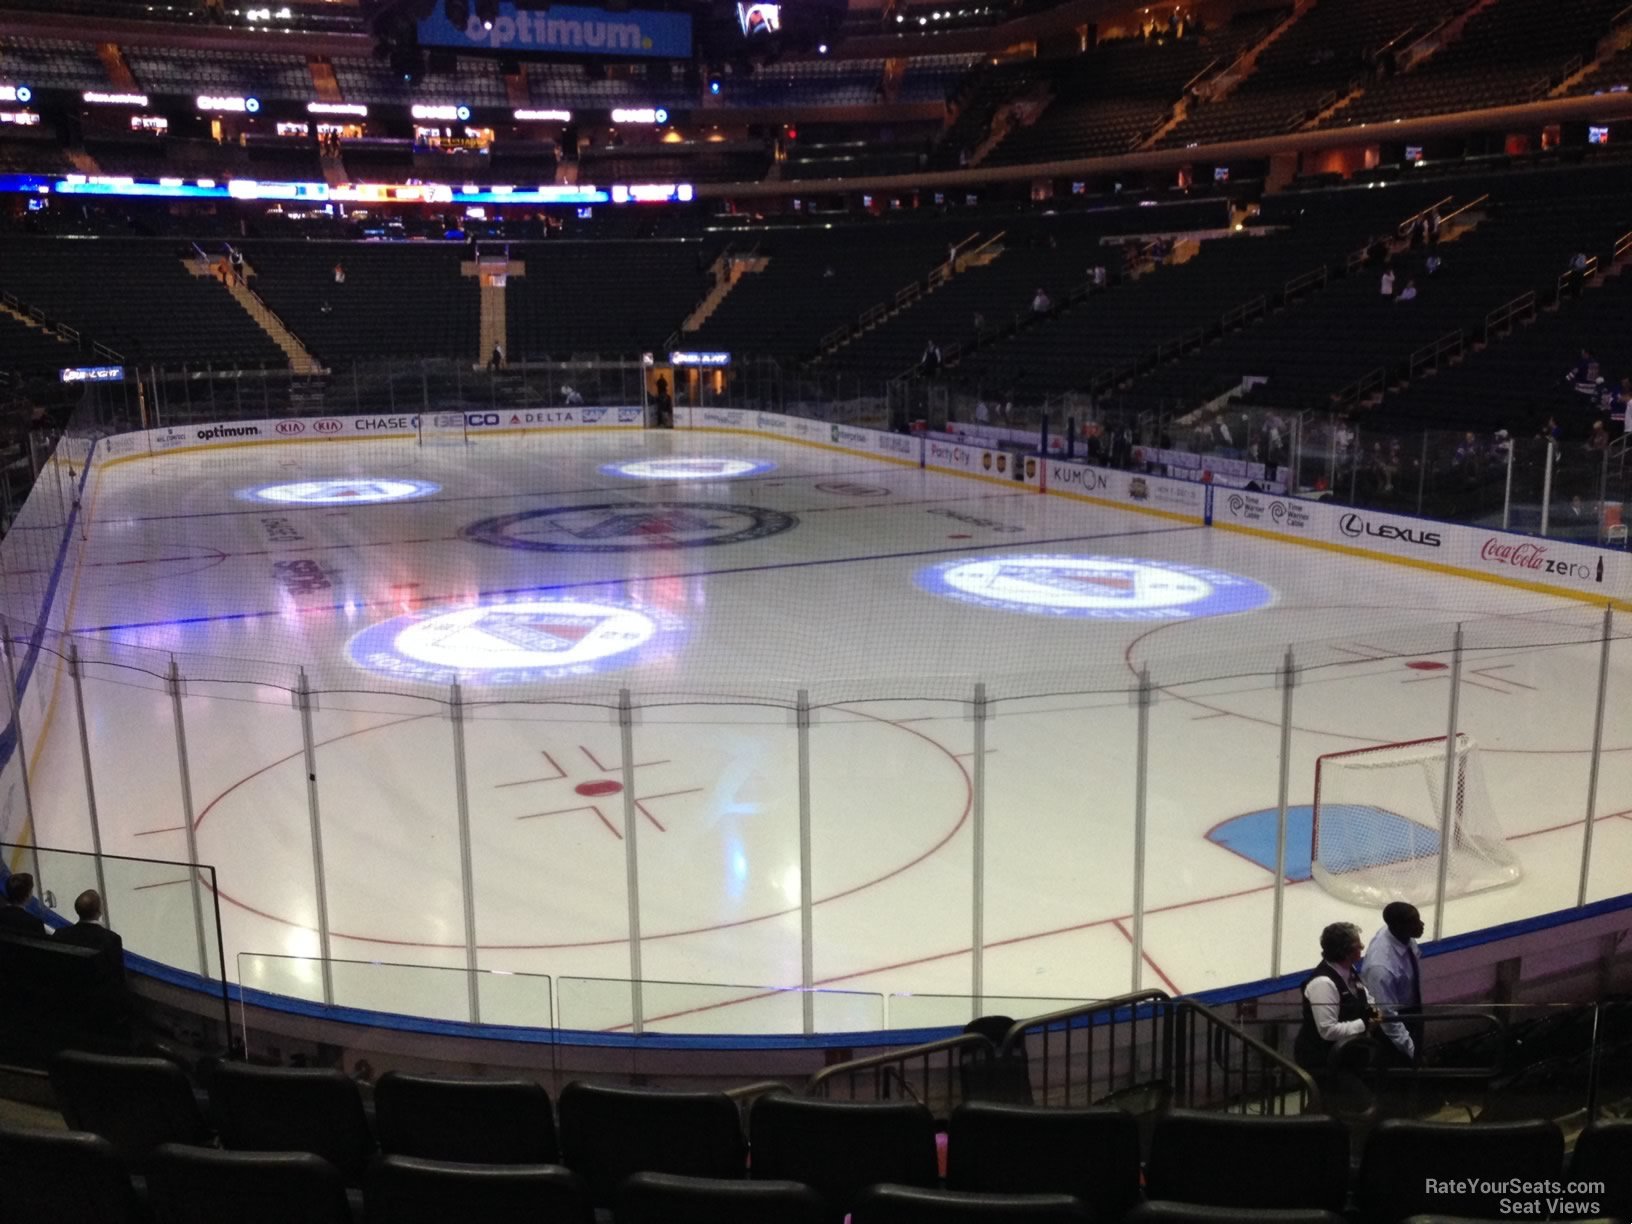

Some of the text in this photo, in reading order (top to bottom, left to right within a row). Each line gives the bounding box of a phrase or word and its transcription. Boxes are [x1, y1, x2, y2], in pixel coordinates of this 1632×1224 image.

[355, 418, 407, 430] CHASE
[525, 413, 573, 424] DELTA
[197, 425, 258, 440] optimum
[280, 422, 300, 432] KIA
[318, 421, 338, 431] KIA
[1054, 467, 1107, 490] KUMON
[1366, 522, 1441, 547] LEXUS
[1545, 560, 1590, 579] zero
